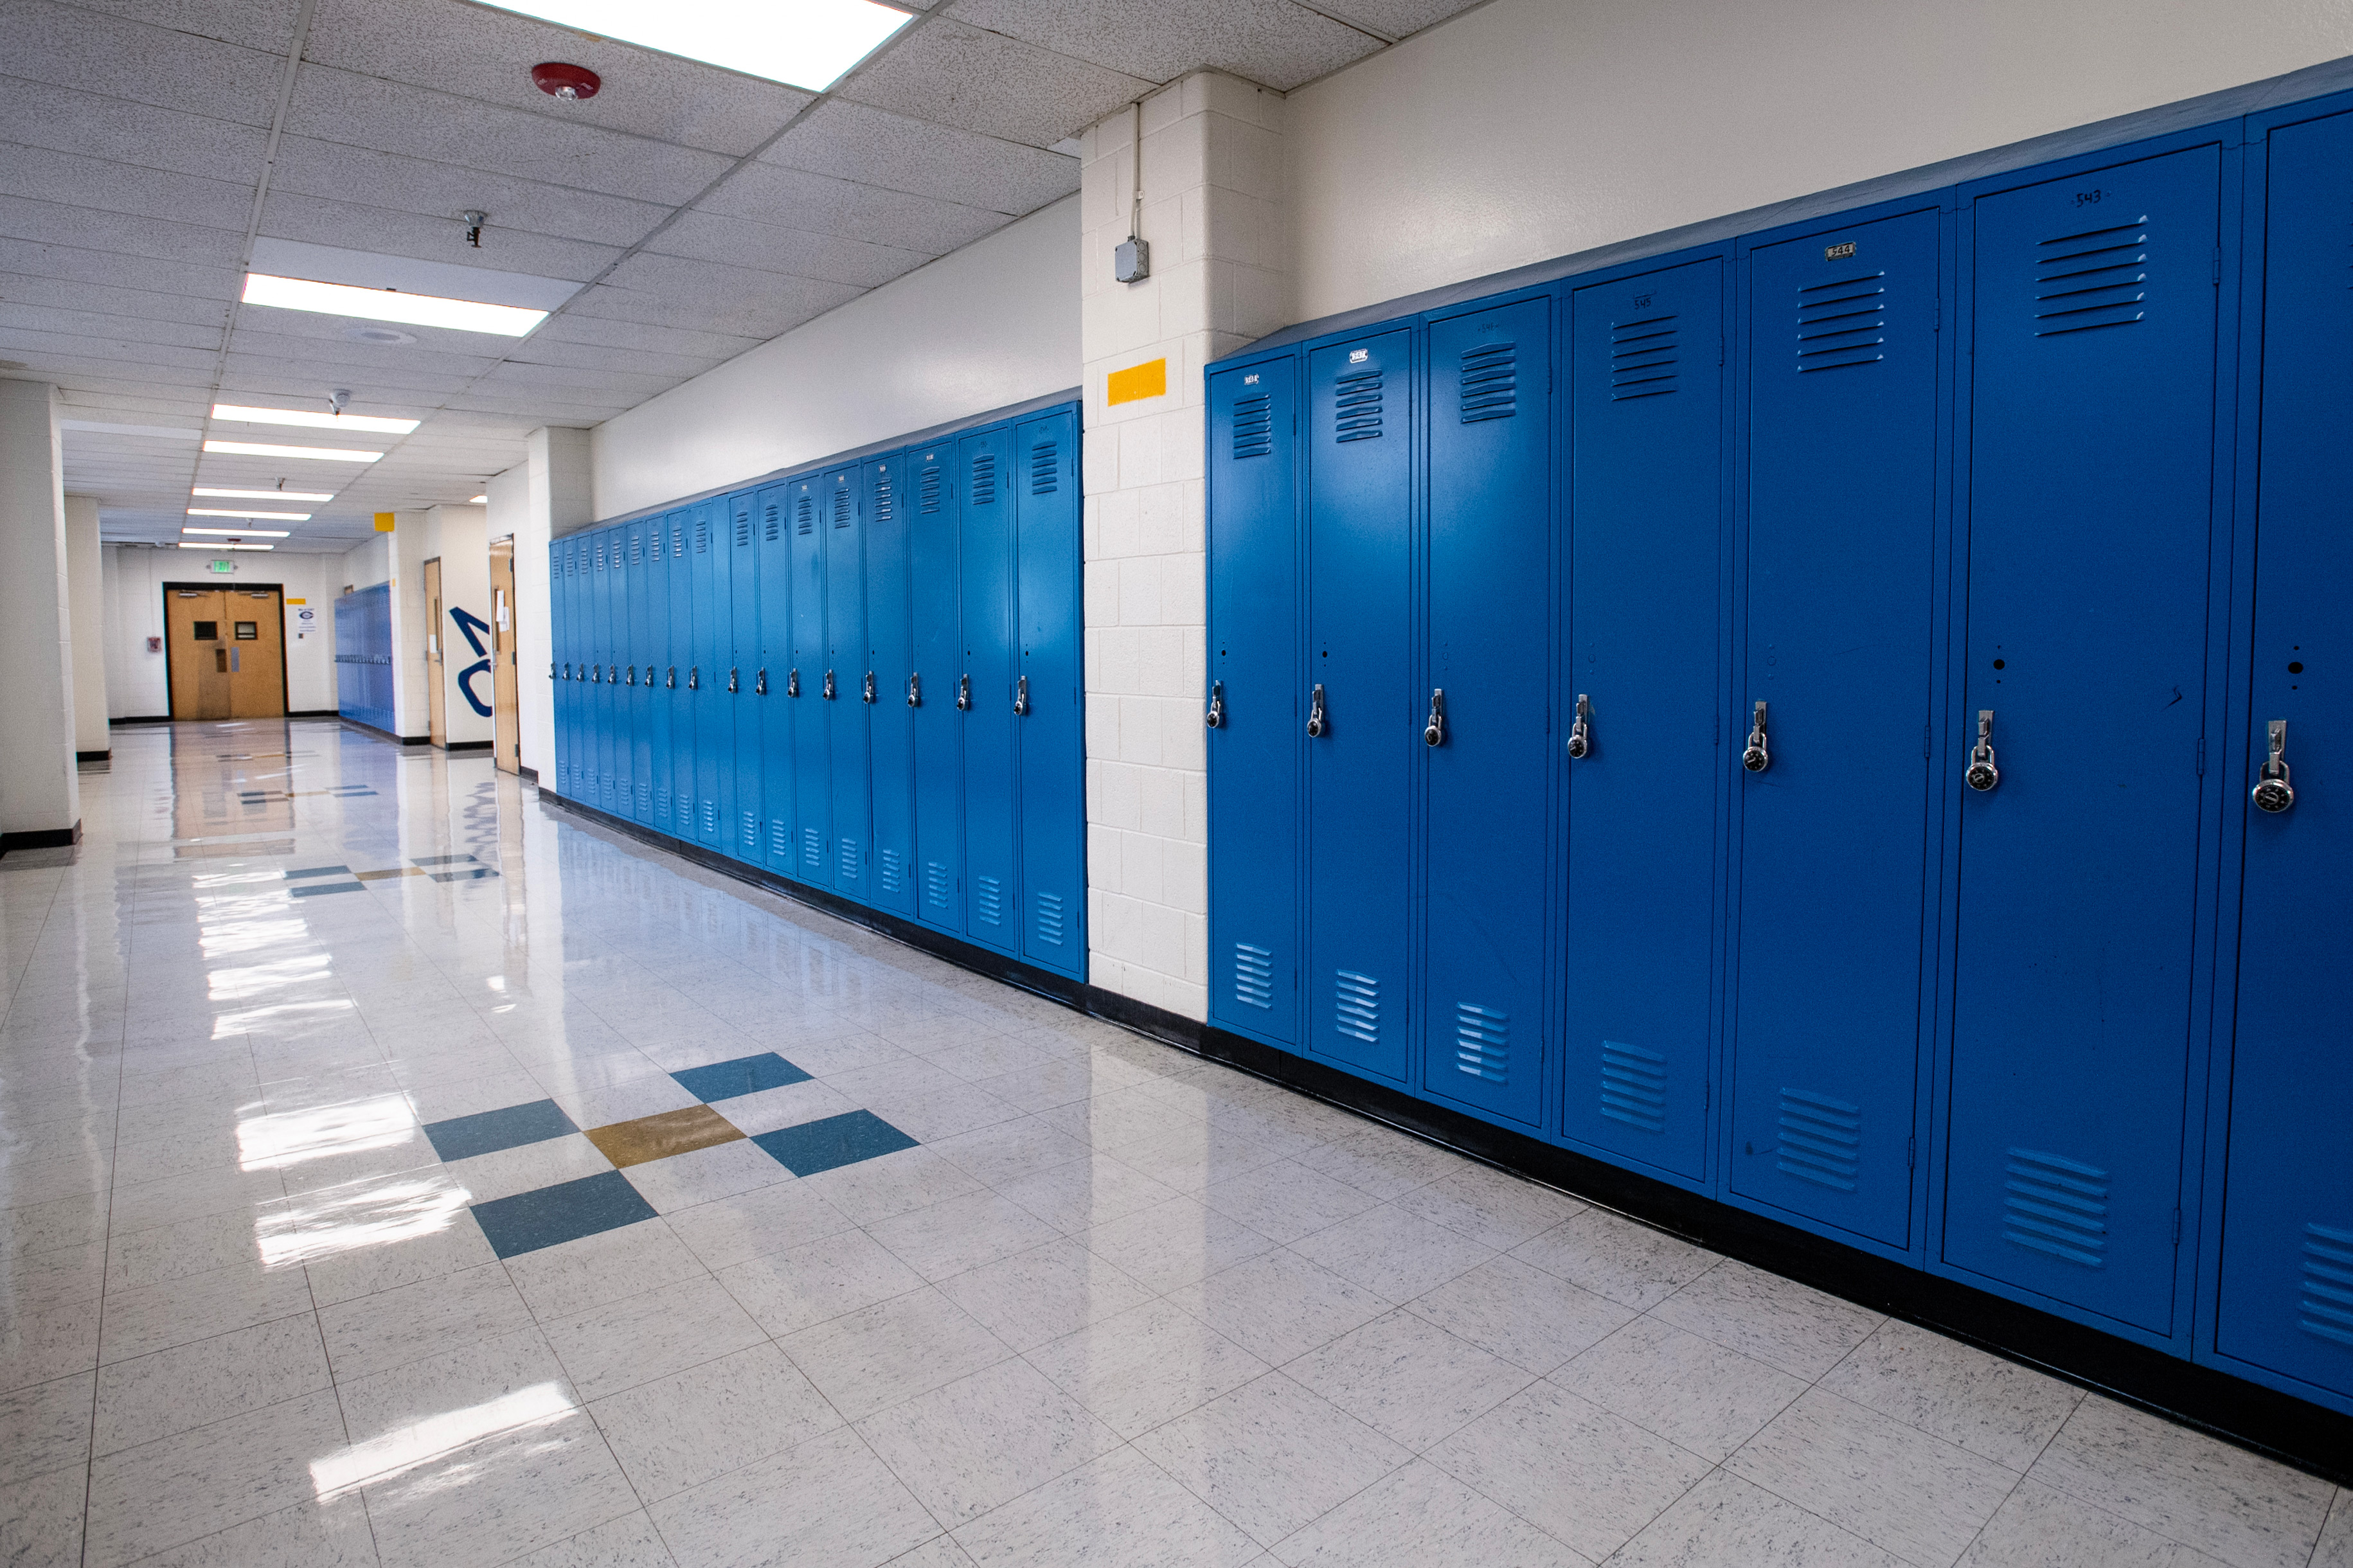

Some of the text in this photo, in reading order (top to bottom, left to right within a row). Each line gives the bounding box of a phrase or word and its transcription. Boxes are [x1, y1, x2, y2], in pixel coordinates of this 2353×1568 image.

[2077, 190, 2100, 208] 543
[1832, 245, 1850, 256] 544
[1634, 297, 1651, 310] 545
